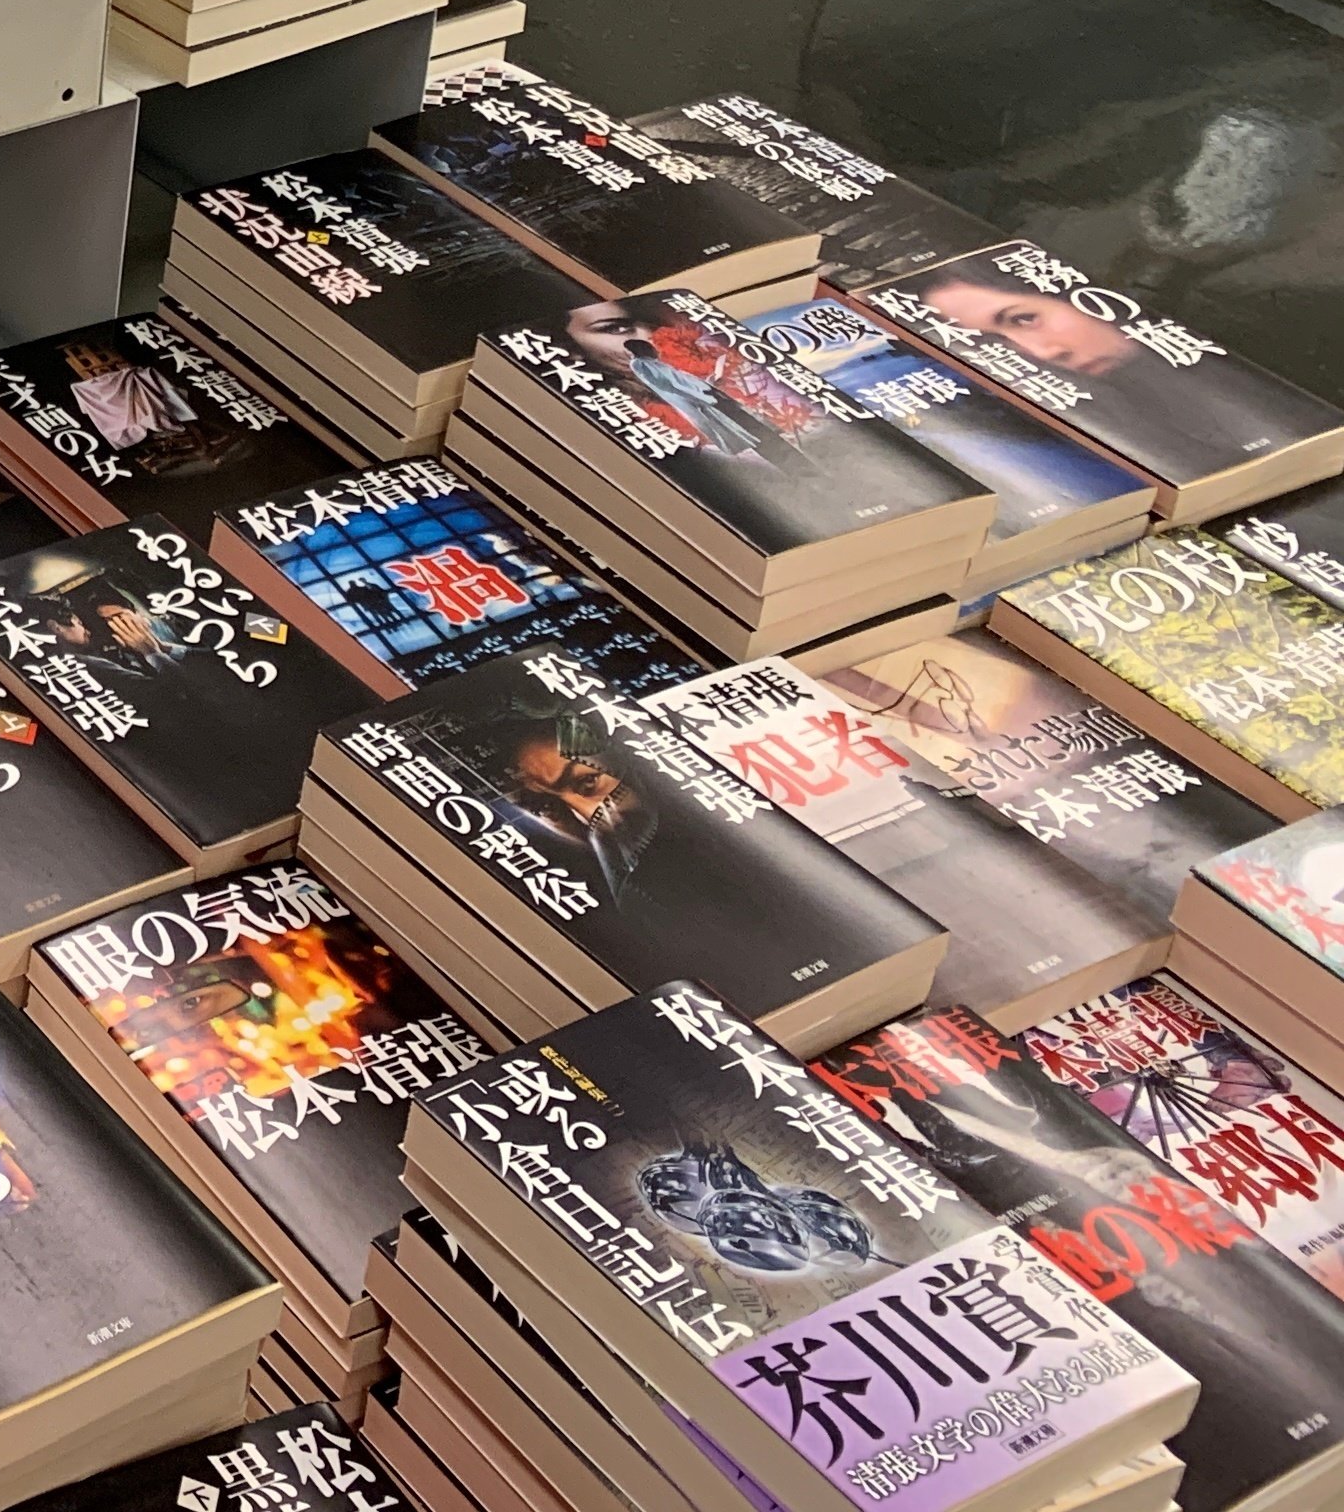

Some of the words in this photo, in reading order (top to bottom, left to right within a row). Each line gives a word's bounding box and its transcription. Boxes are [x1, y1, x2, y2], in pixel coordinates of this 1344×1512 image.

[471, 97, 646, 192] 松本清張
[523, 81, 716, 187] 状況曲線
[681, 101, 873, 204] 憎悪の依頼
[717, 93, 897, 187] 松本清張
[198, 187, 382, 307] 状況曲線
[260, 170, 431, 275] 松本清張
[667, 291, 873, 425] 喪失の儀礼
[867, 287, 1093, 412] 松本清張
[995, 246, 1228, 371] 霧の旗
[124, 319, 290, 431] 松本清張
[500, 327, 701, 461] 松本清張
[236, 457, 470, 548] 松本清張
[128, 528, 253, 615] わるい
[386, 545, 530, 627] 渦
[1038, 538, 1270, 648] 死の枝
[145, 587, 278, 688] やつら
[522, 650, 776, 825] 松本清張
[944, 704, 1147, 795] された場面
[342, 721, 599, 921] 時間の習俗
[44, 865, 351, 1003] 眼の気流
[790, 960, 831, 982] 新潮文庫
[192, 1012, 497, 1162] 松本清張
[488, 1059, 609, 1154] 或る
[653, 987, 962, 1220] 松本清張
[424, 1078, 756, 1357] 「小倉日記」伝
[85, 1315, 138, 1347] 新潮文庫
[987, 1233, 1113, 1331] 受賞作
[737, 1256, 1080, 1469] 芥川賞
[845, 1330, 1160, 1502] 清張文学の偉大なる原点
[1007, 1421, 1059, 1458] 新潮文庫
